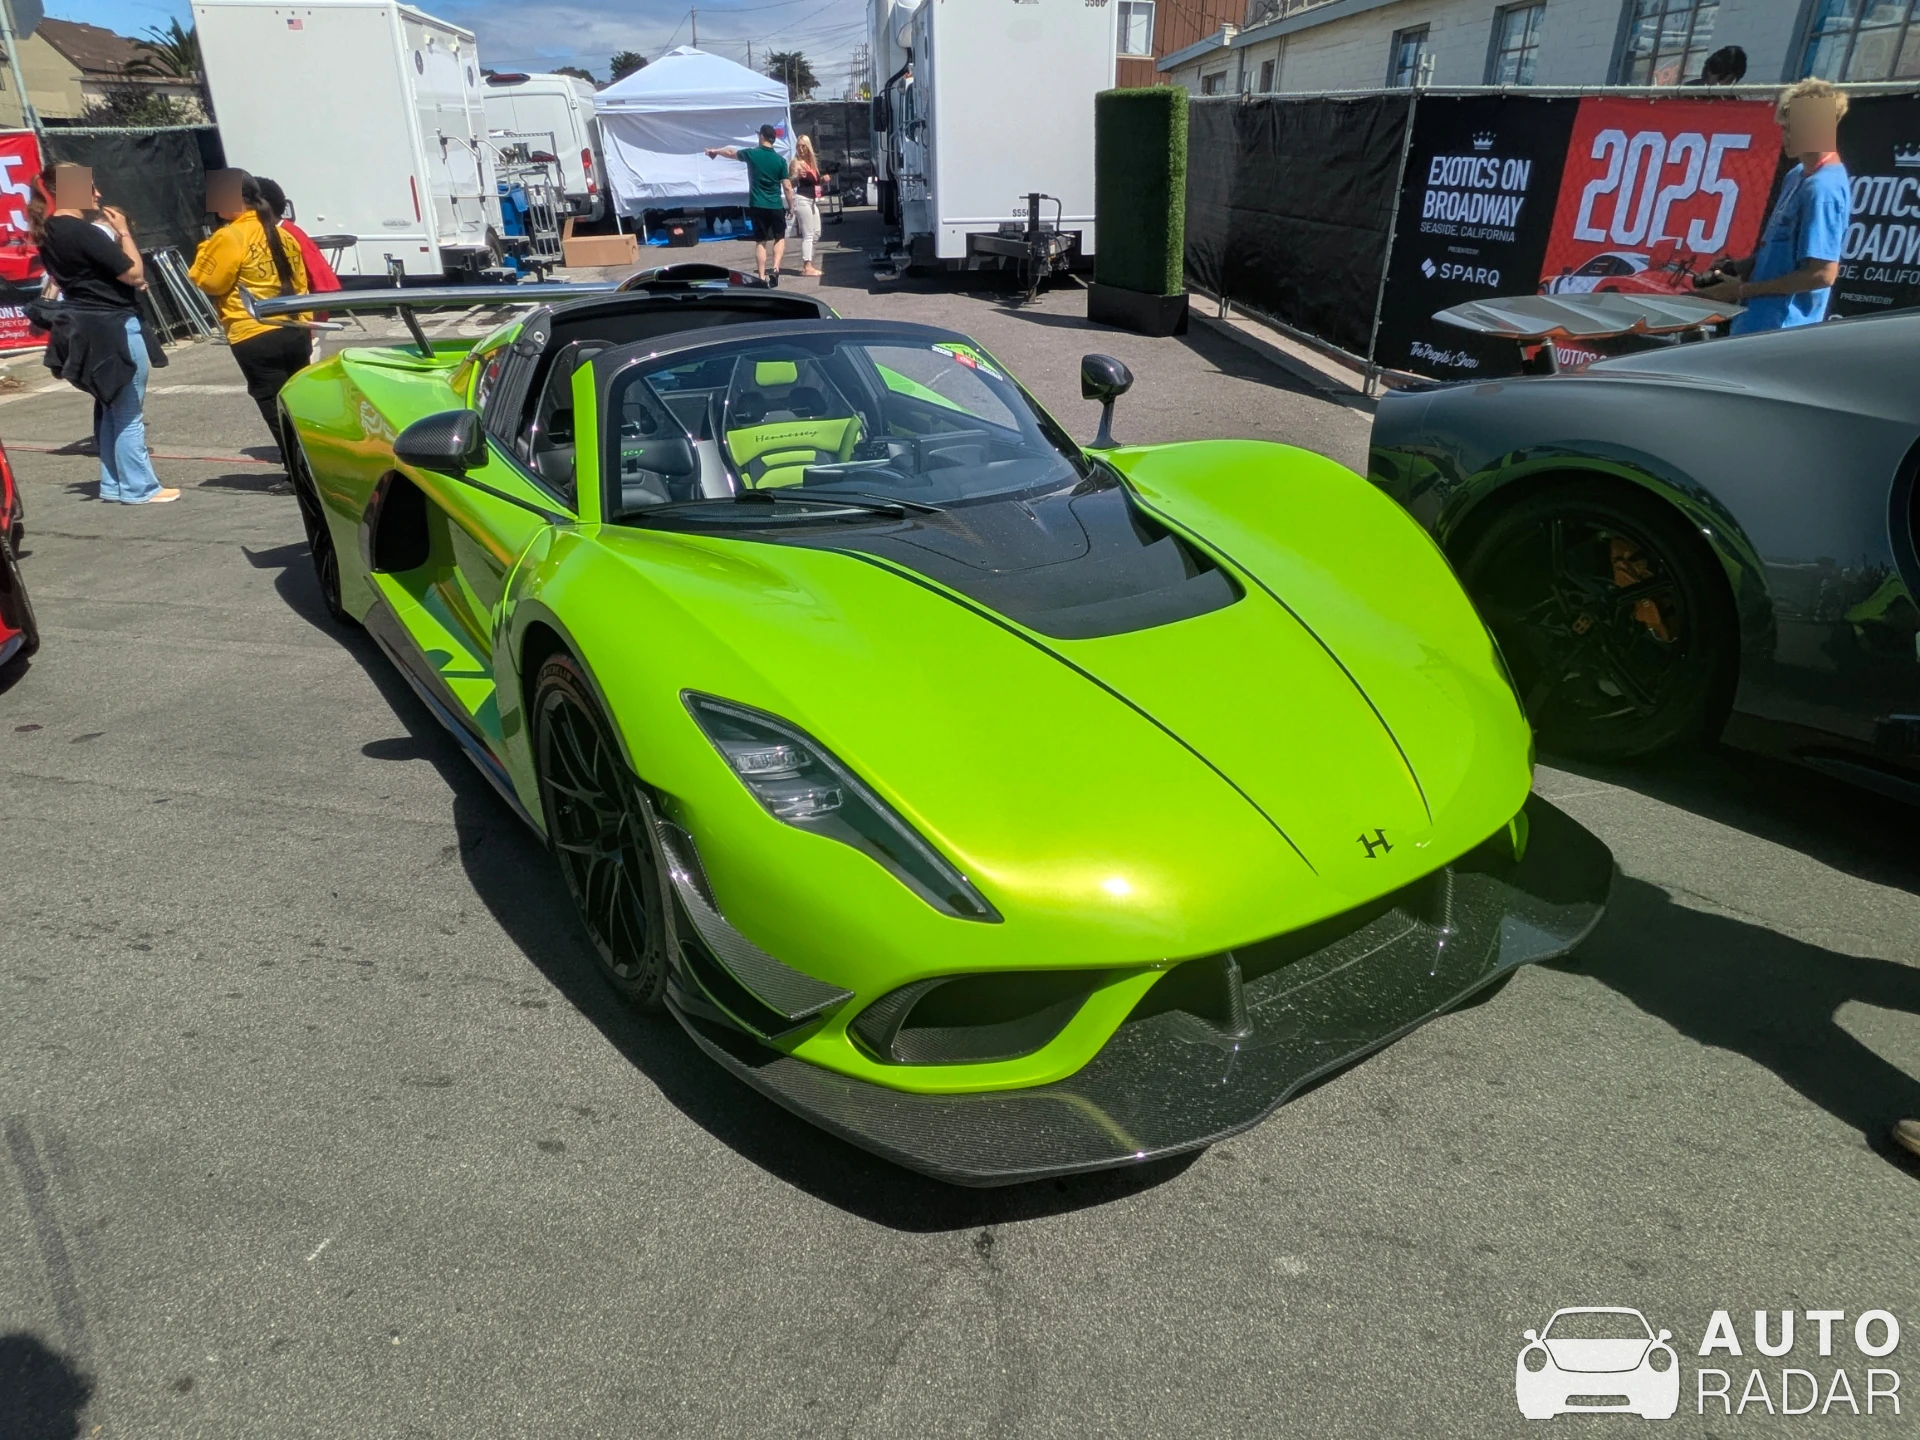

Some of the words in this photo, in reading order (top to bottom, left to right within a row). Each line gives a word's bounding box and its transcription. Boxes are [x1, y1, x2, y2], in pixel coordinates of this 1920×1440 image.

[1427, 156, 1500, 189] EXOTICS
[1501, 159, 1531, 191] ON
[1573, 129, 1751, 254] 2025
[1849, 176, 1920, 219] OTIC
[1422, 190, 1525, 227] BROADWAY
[1420, 221, 1459, 237] SEASIDE,
[1460, 225, 1515, 242] CALIFORNIA
[1439, 262, 1500, 287] SPARQ
[1839, 292, 1882, 304] PRESENTED
[1882, 296, 1894, 305] BY
[1410, 341, 1424, 357] The
[1422, 343, 1456, 366] People's
[1454, 351, 1480, 368] Show
[755, 430, 819, 442] Hennessey
